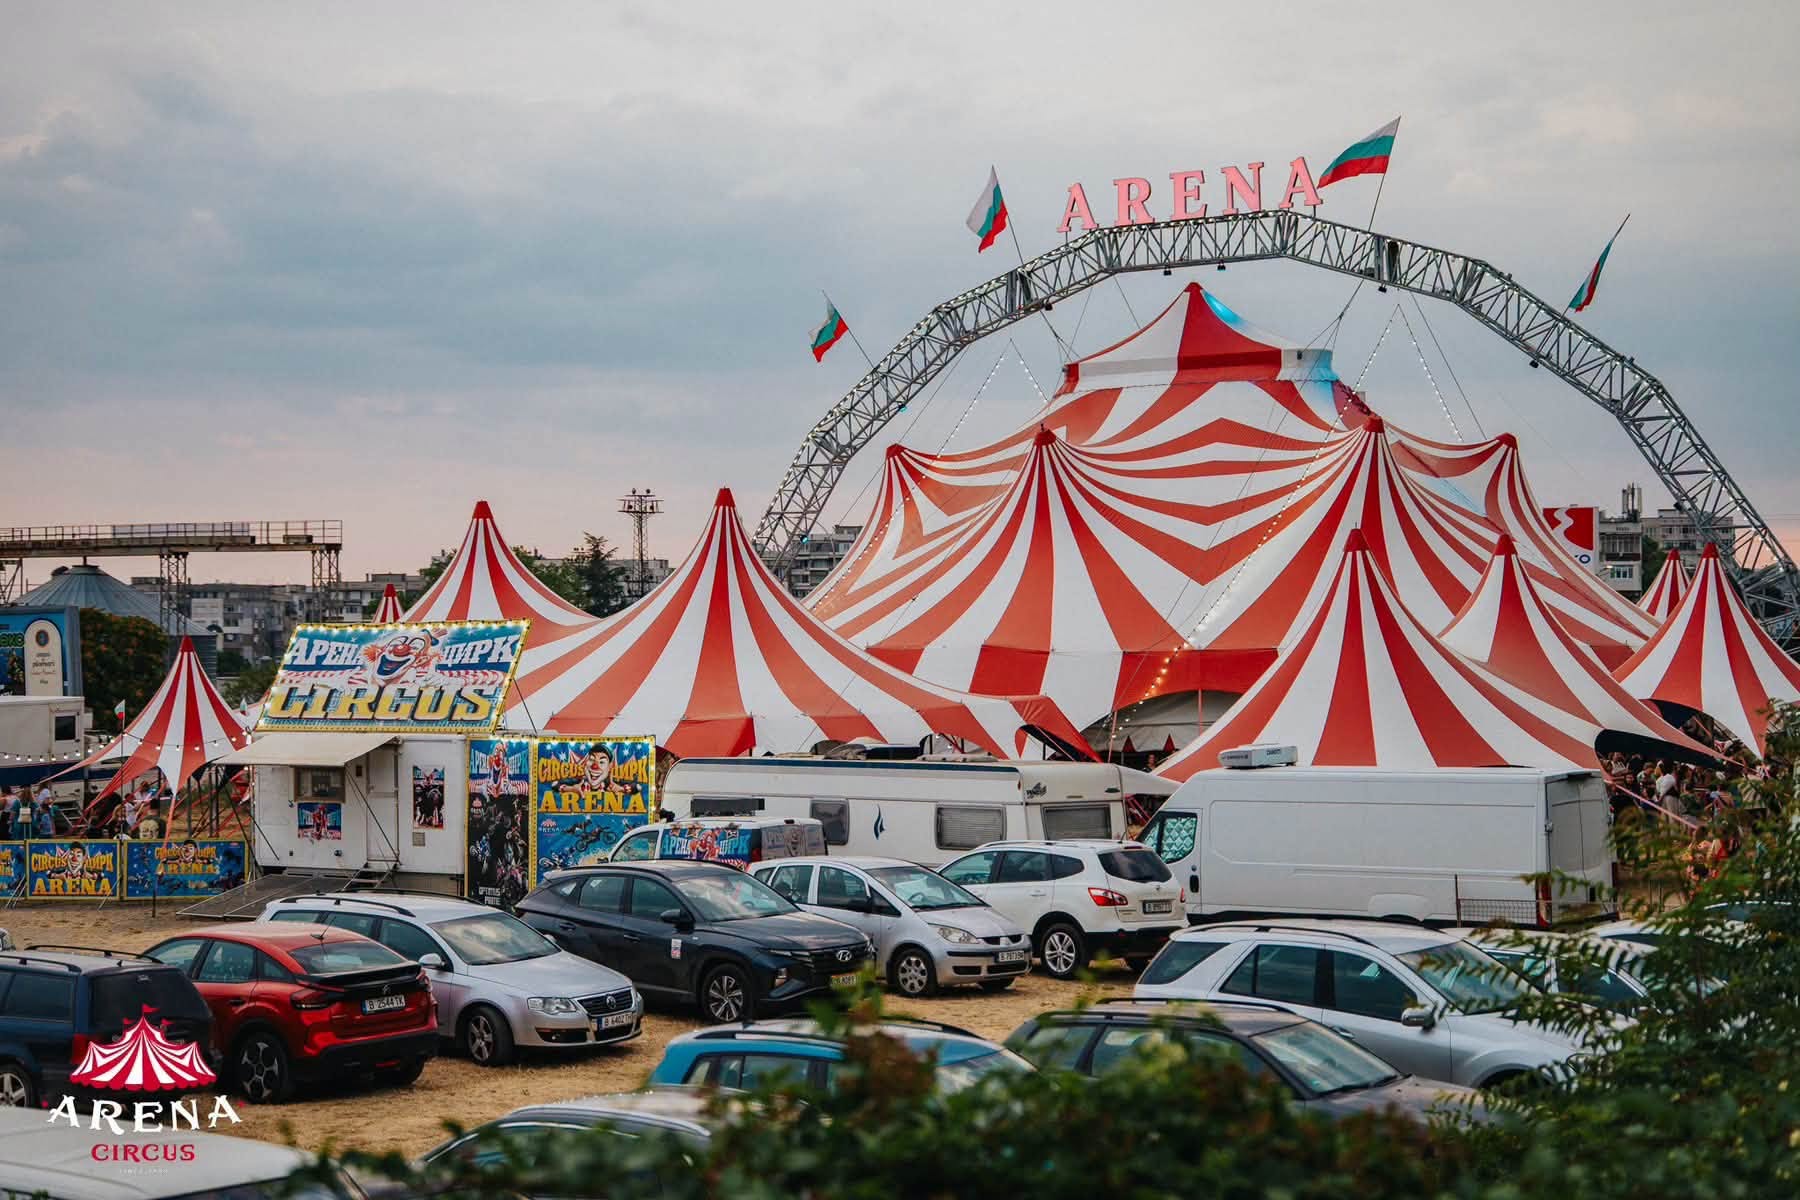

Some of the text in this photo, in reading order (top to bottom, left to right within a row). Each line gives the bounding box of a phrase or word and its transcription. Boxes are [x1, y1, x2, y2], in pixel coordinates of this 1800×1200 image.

[1056, 156, 1324, 232] ARENA
[442, 634, 521, 667] ЦИРК
[268, 683, 498, 722] CIRCUS
[538, 757, 585, 784] CIRCUS
[538, 790, 648, 814] ARENA
[32, 852, 68, 873] CIRCUS
[155, 863, 217, 875] ARENA
[32, 878, 113, 896] ARENA
